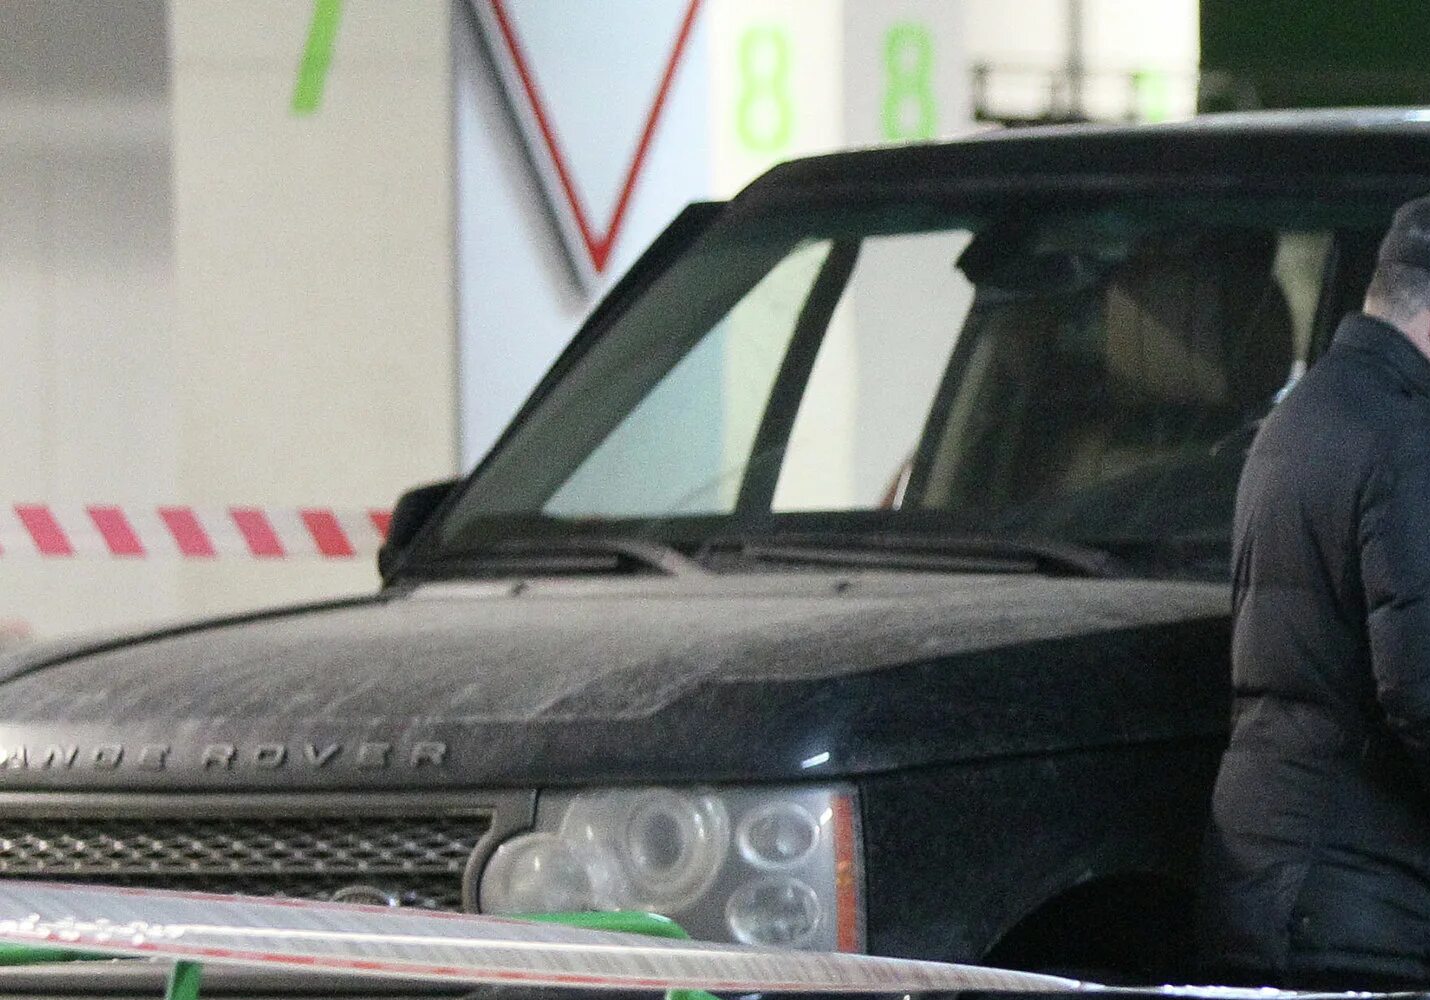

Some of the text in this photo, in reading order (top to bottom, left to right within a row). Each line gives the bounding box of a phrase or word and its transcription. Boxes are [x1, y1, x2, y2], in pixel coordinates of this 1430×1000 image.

[738, 24, 792, 153] 8
[882, 22, 936, 141] 8
[201, 742, 447, 771] ROVER
